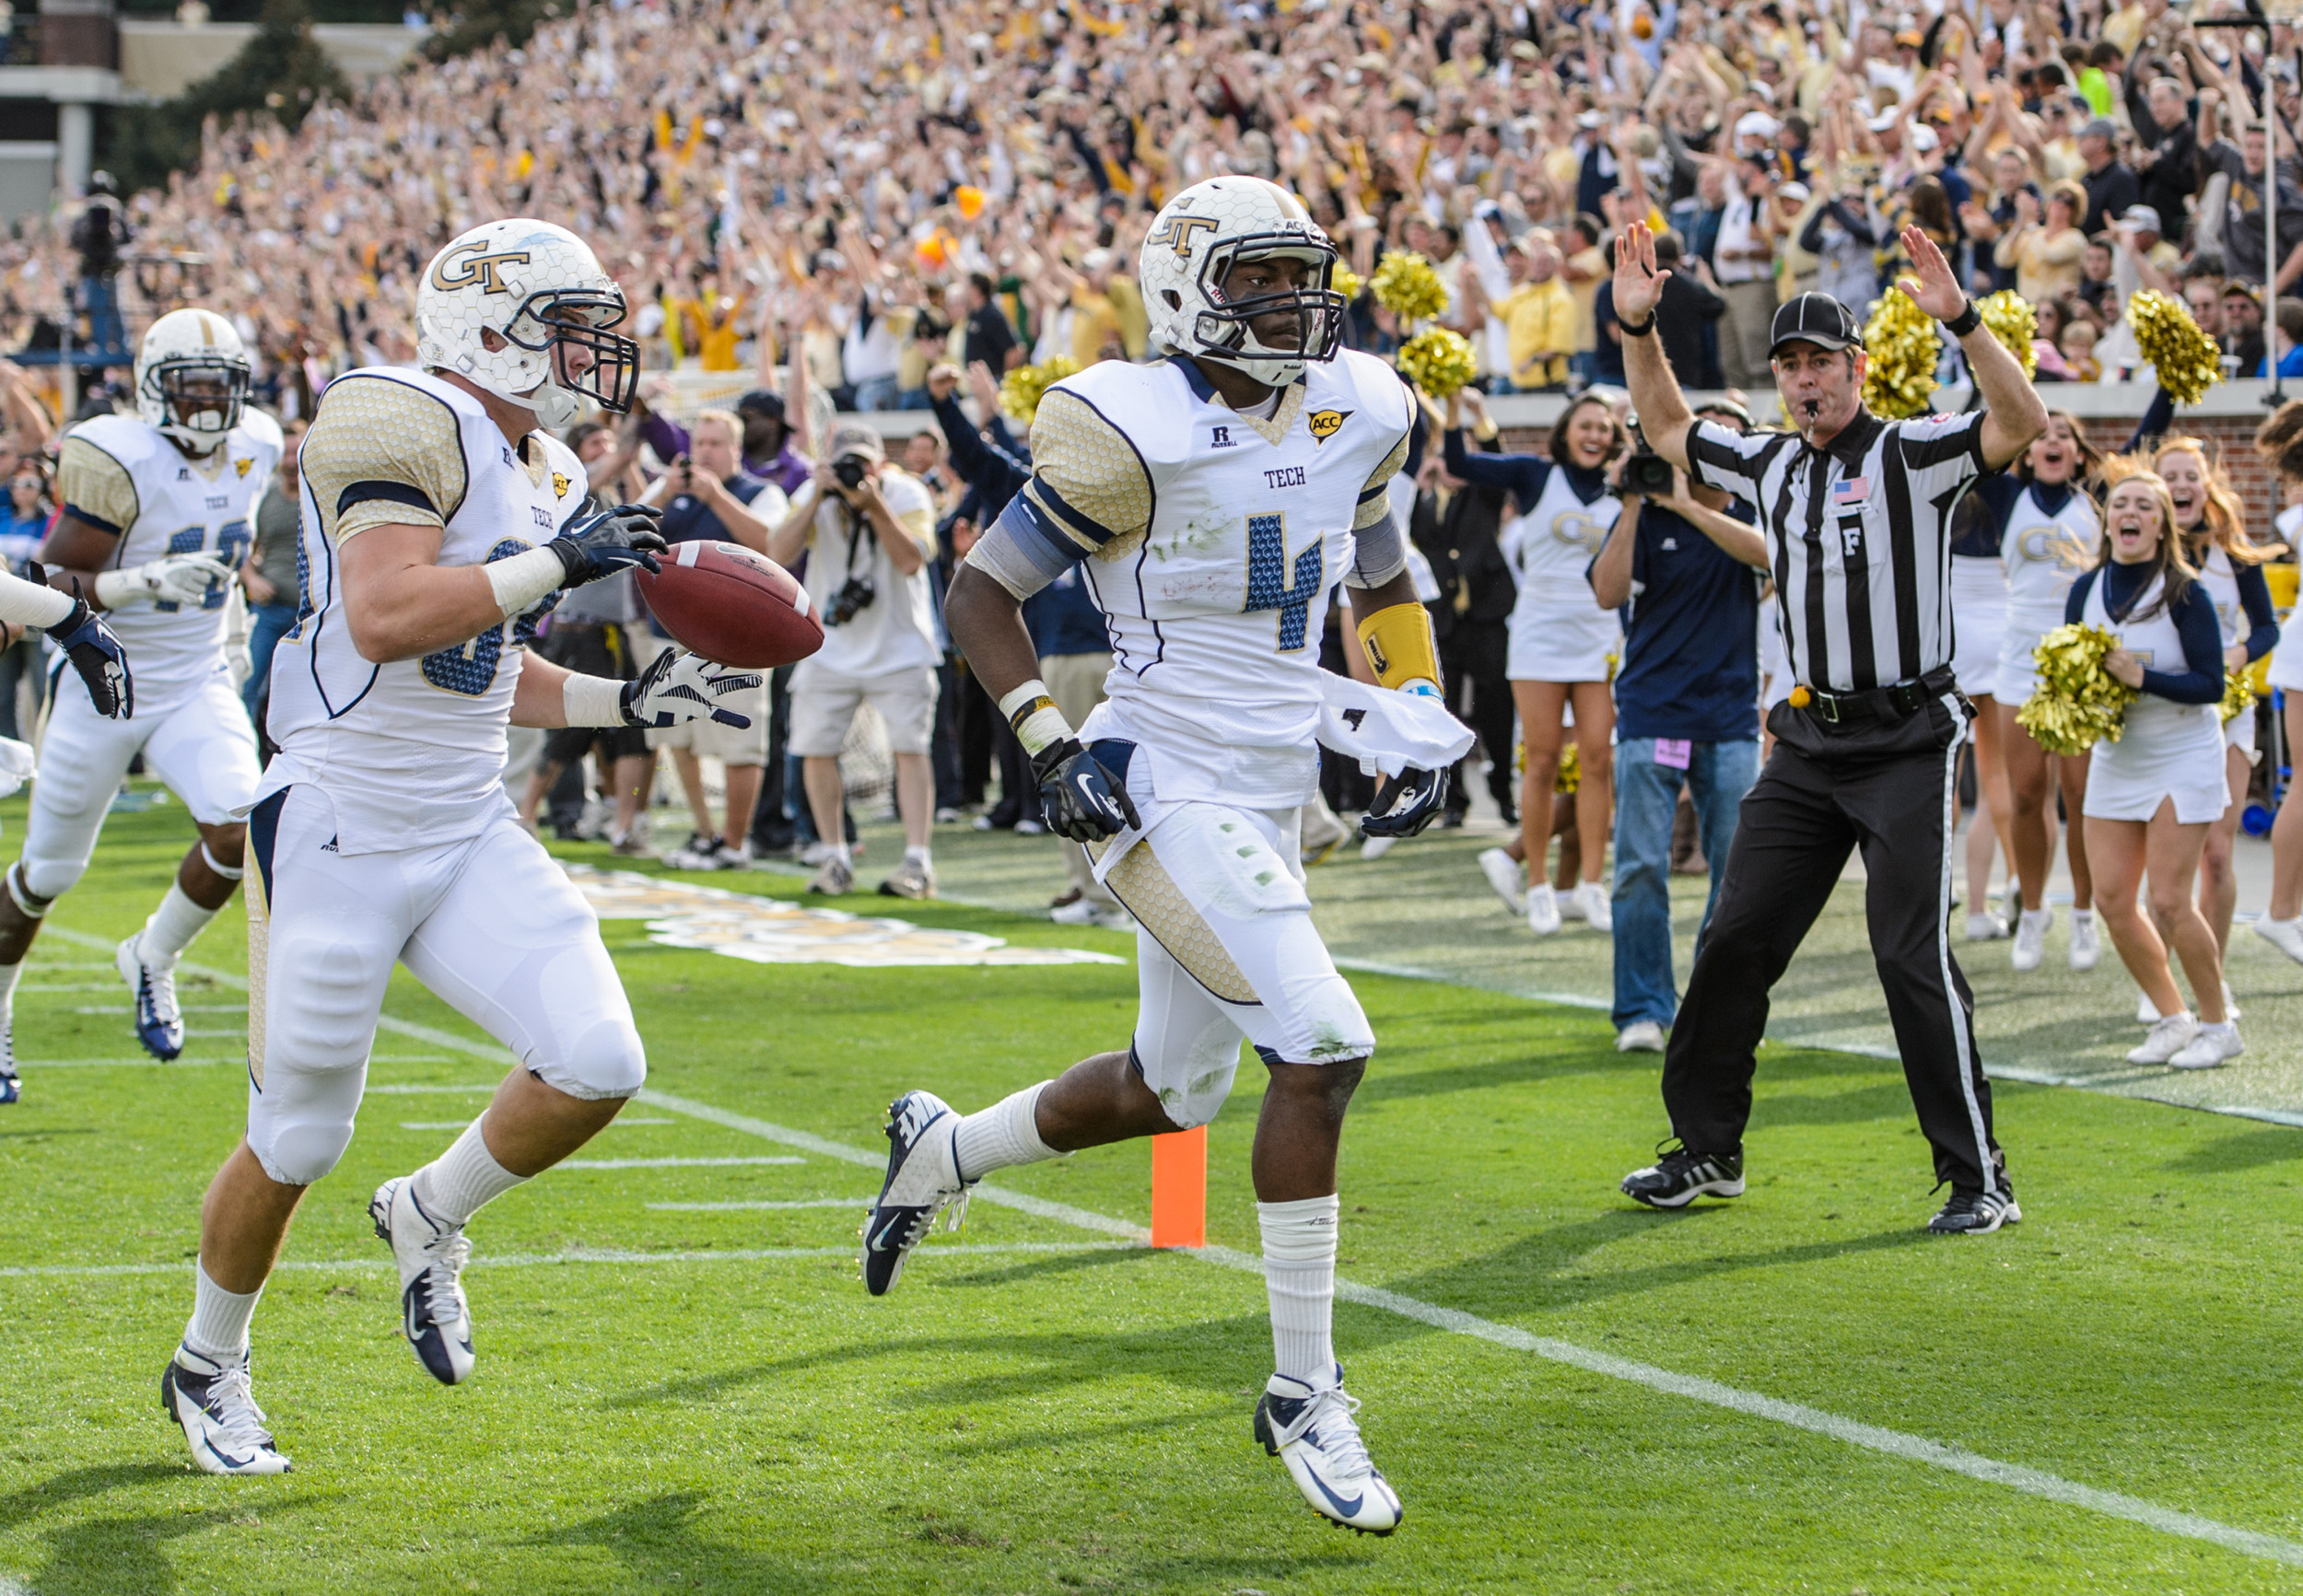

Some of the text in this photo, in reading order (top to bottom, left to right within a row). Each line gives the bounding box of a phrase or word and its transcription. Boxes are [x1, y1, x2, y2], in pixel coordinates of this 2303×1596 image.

[432, 239, 530, 295] GT
[1212, 426, 1229, 442] R
[1313, 416, 1339, 430] ACC
[1211, 440, 1238, 449] RUSSELL
[1264, 467, 1305, 489] TECH
[531, 505, 554, 530] TECH
[1842, 527, 1862, 557] F
[1238, 510, 1327, 655] 4
[372, 1177, 400, 1231] IKE
